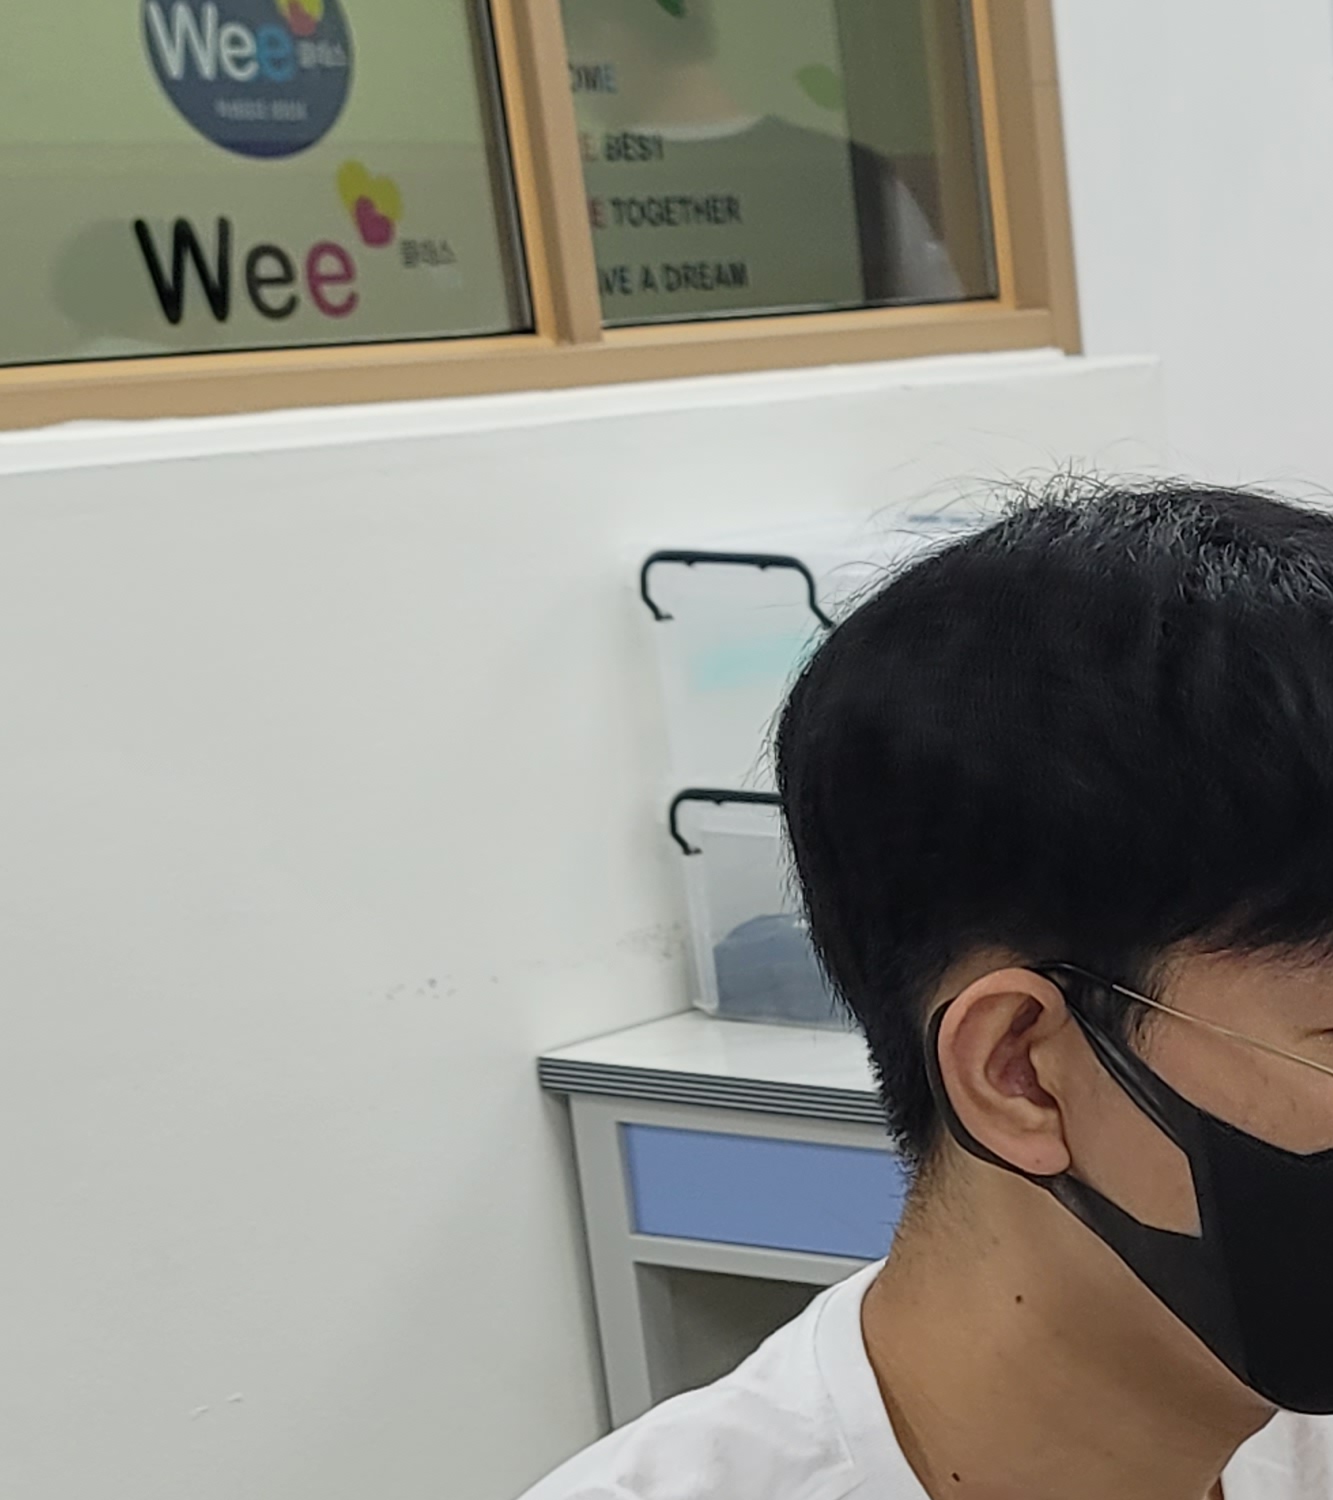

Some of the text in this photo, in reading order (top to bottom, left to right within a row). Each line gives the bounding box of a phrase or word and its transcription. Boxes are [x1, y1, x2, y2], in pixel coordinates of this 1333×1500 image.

[147, 0, 295, 81] Wee
[610, 196, 743, 228] TOGETHER
[134, 216, 359, 324] Wee
[661, 261, 749, 292] DREAM
